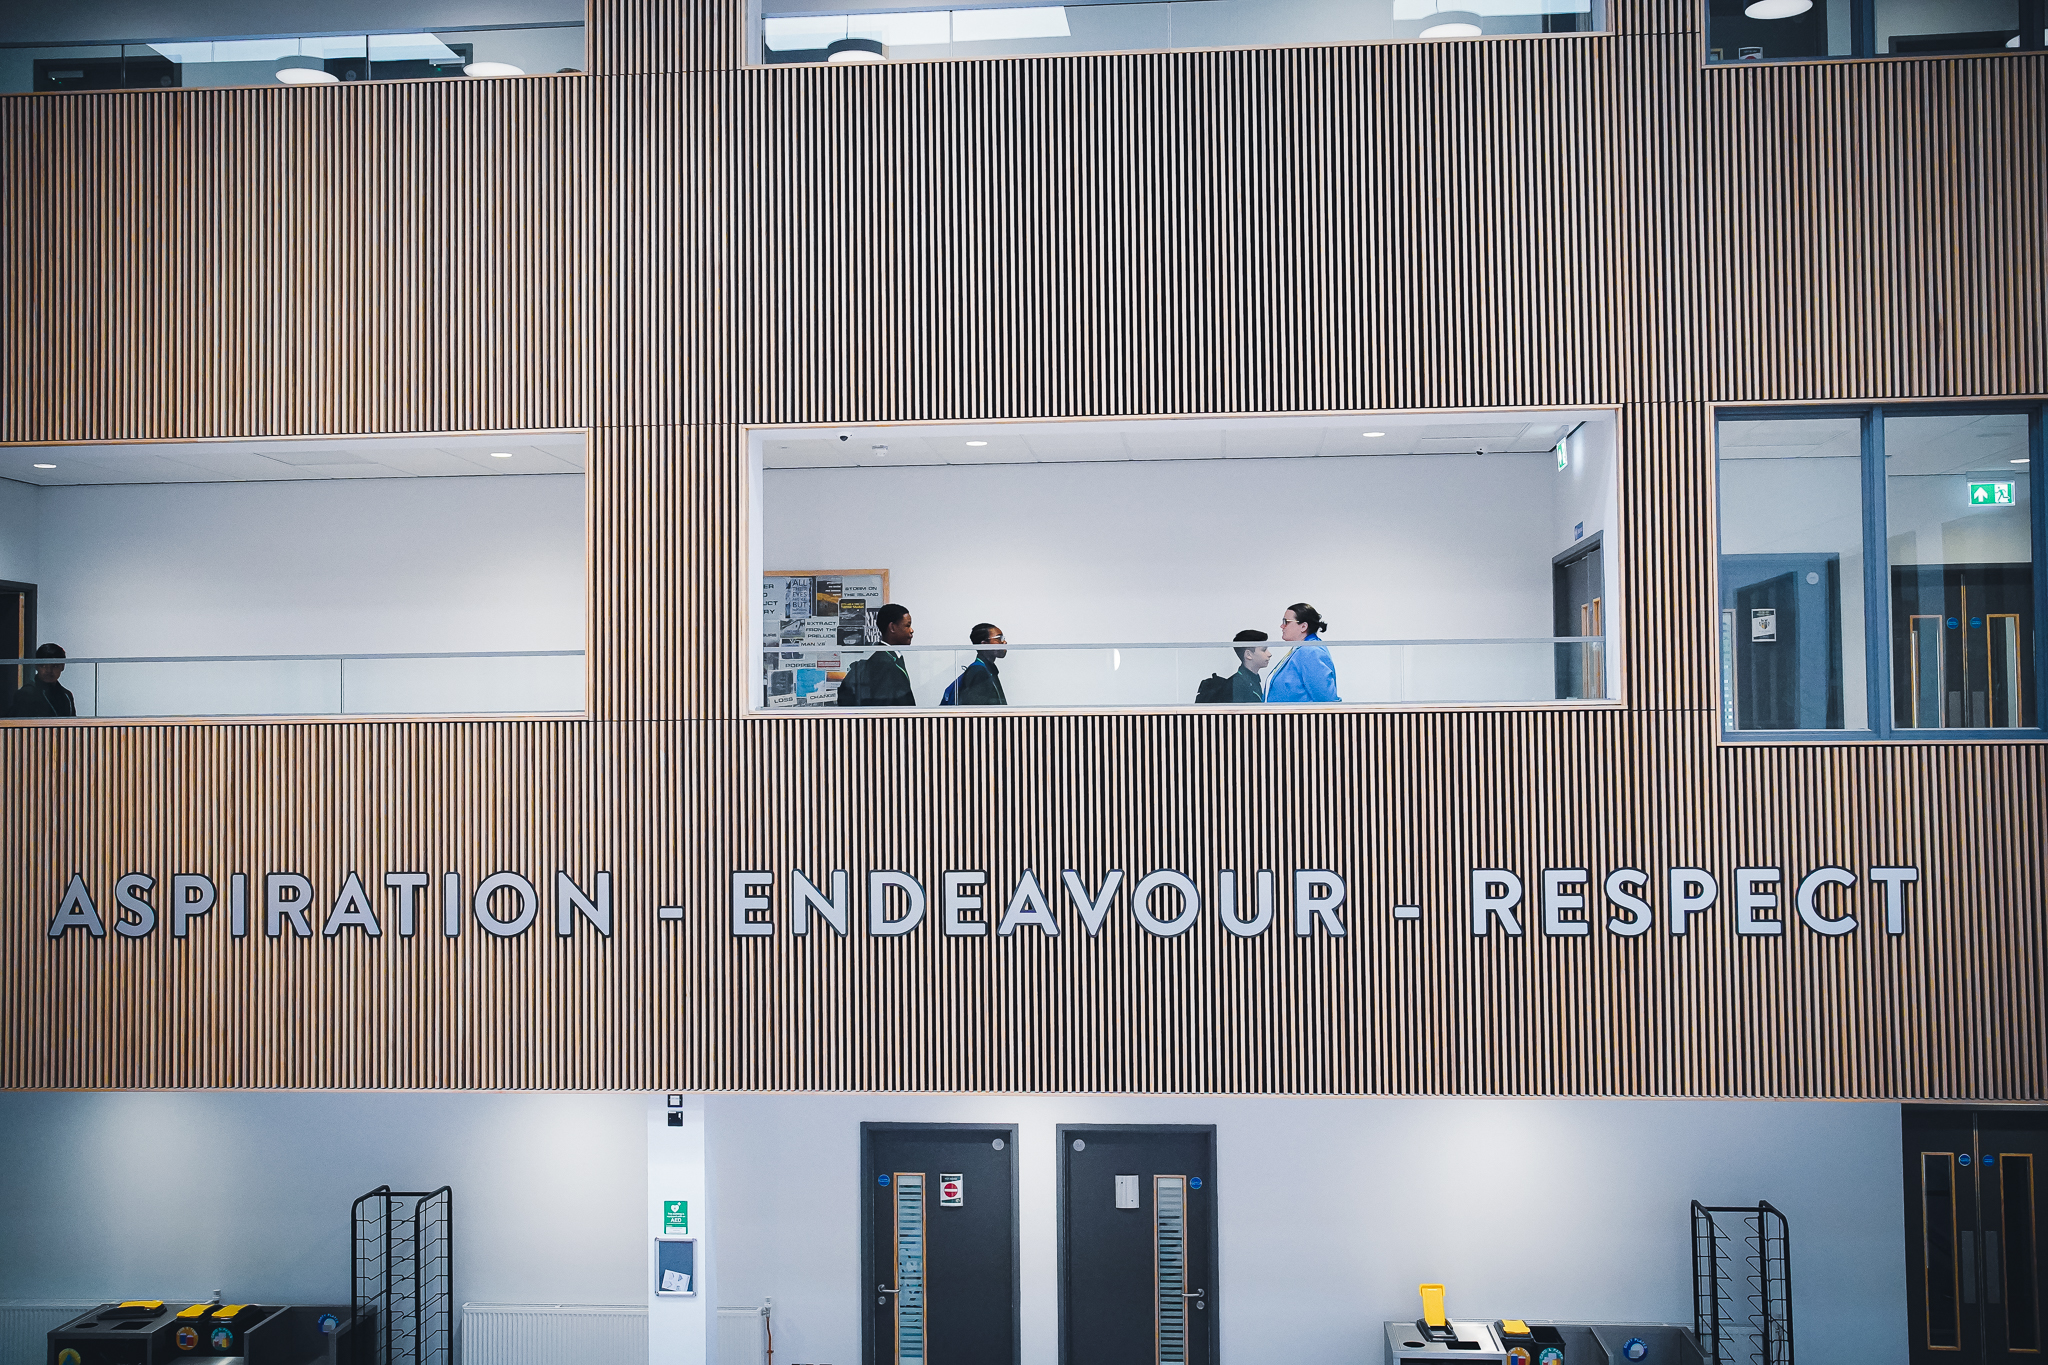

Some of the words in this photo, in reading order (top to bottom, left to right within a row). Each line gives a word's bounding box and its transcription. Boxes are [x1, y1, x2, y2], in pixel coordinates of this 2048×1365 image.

[48, 871, 612, 938] ASPIRATION
[731, 867, 1348, 938] ENDEAVOUR
[1470, 865, 1919, 937] RESPECT
